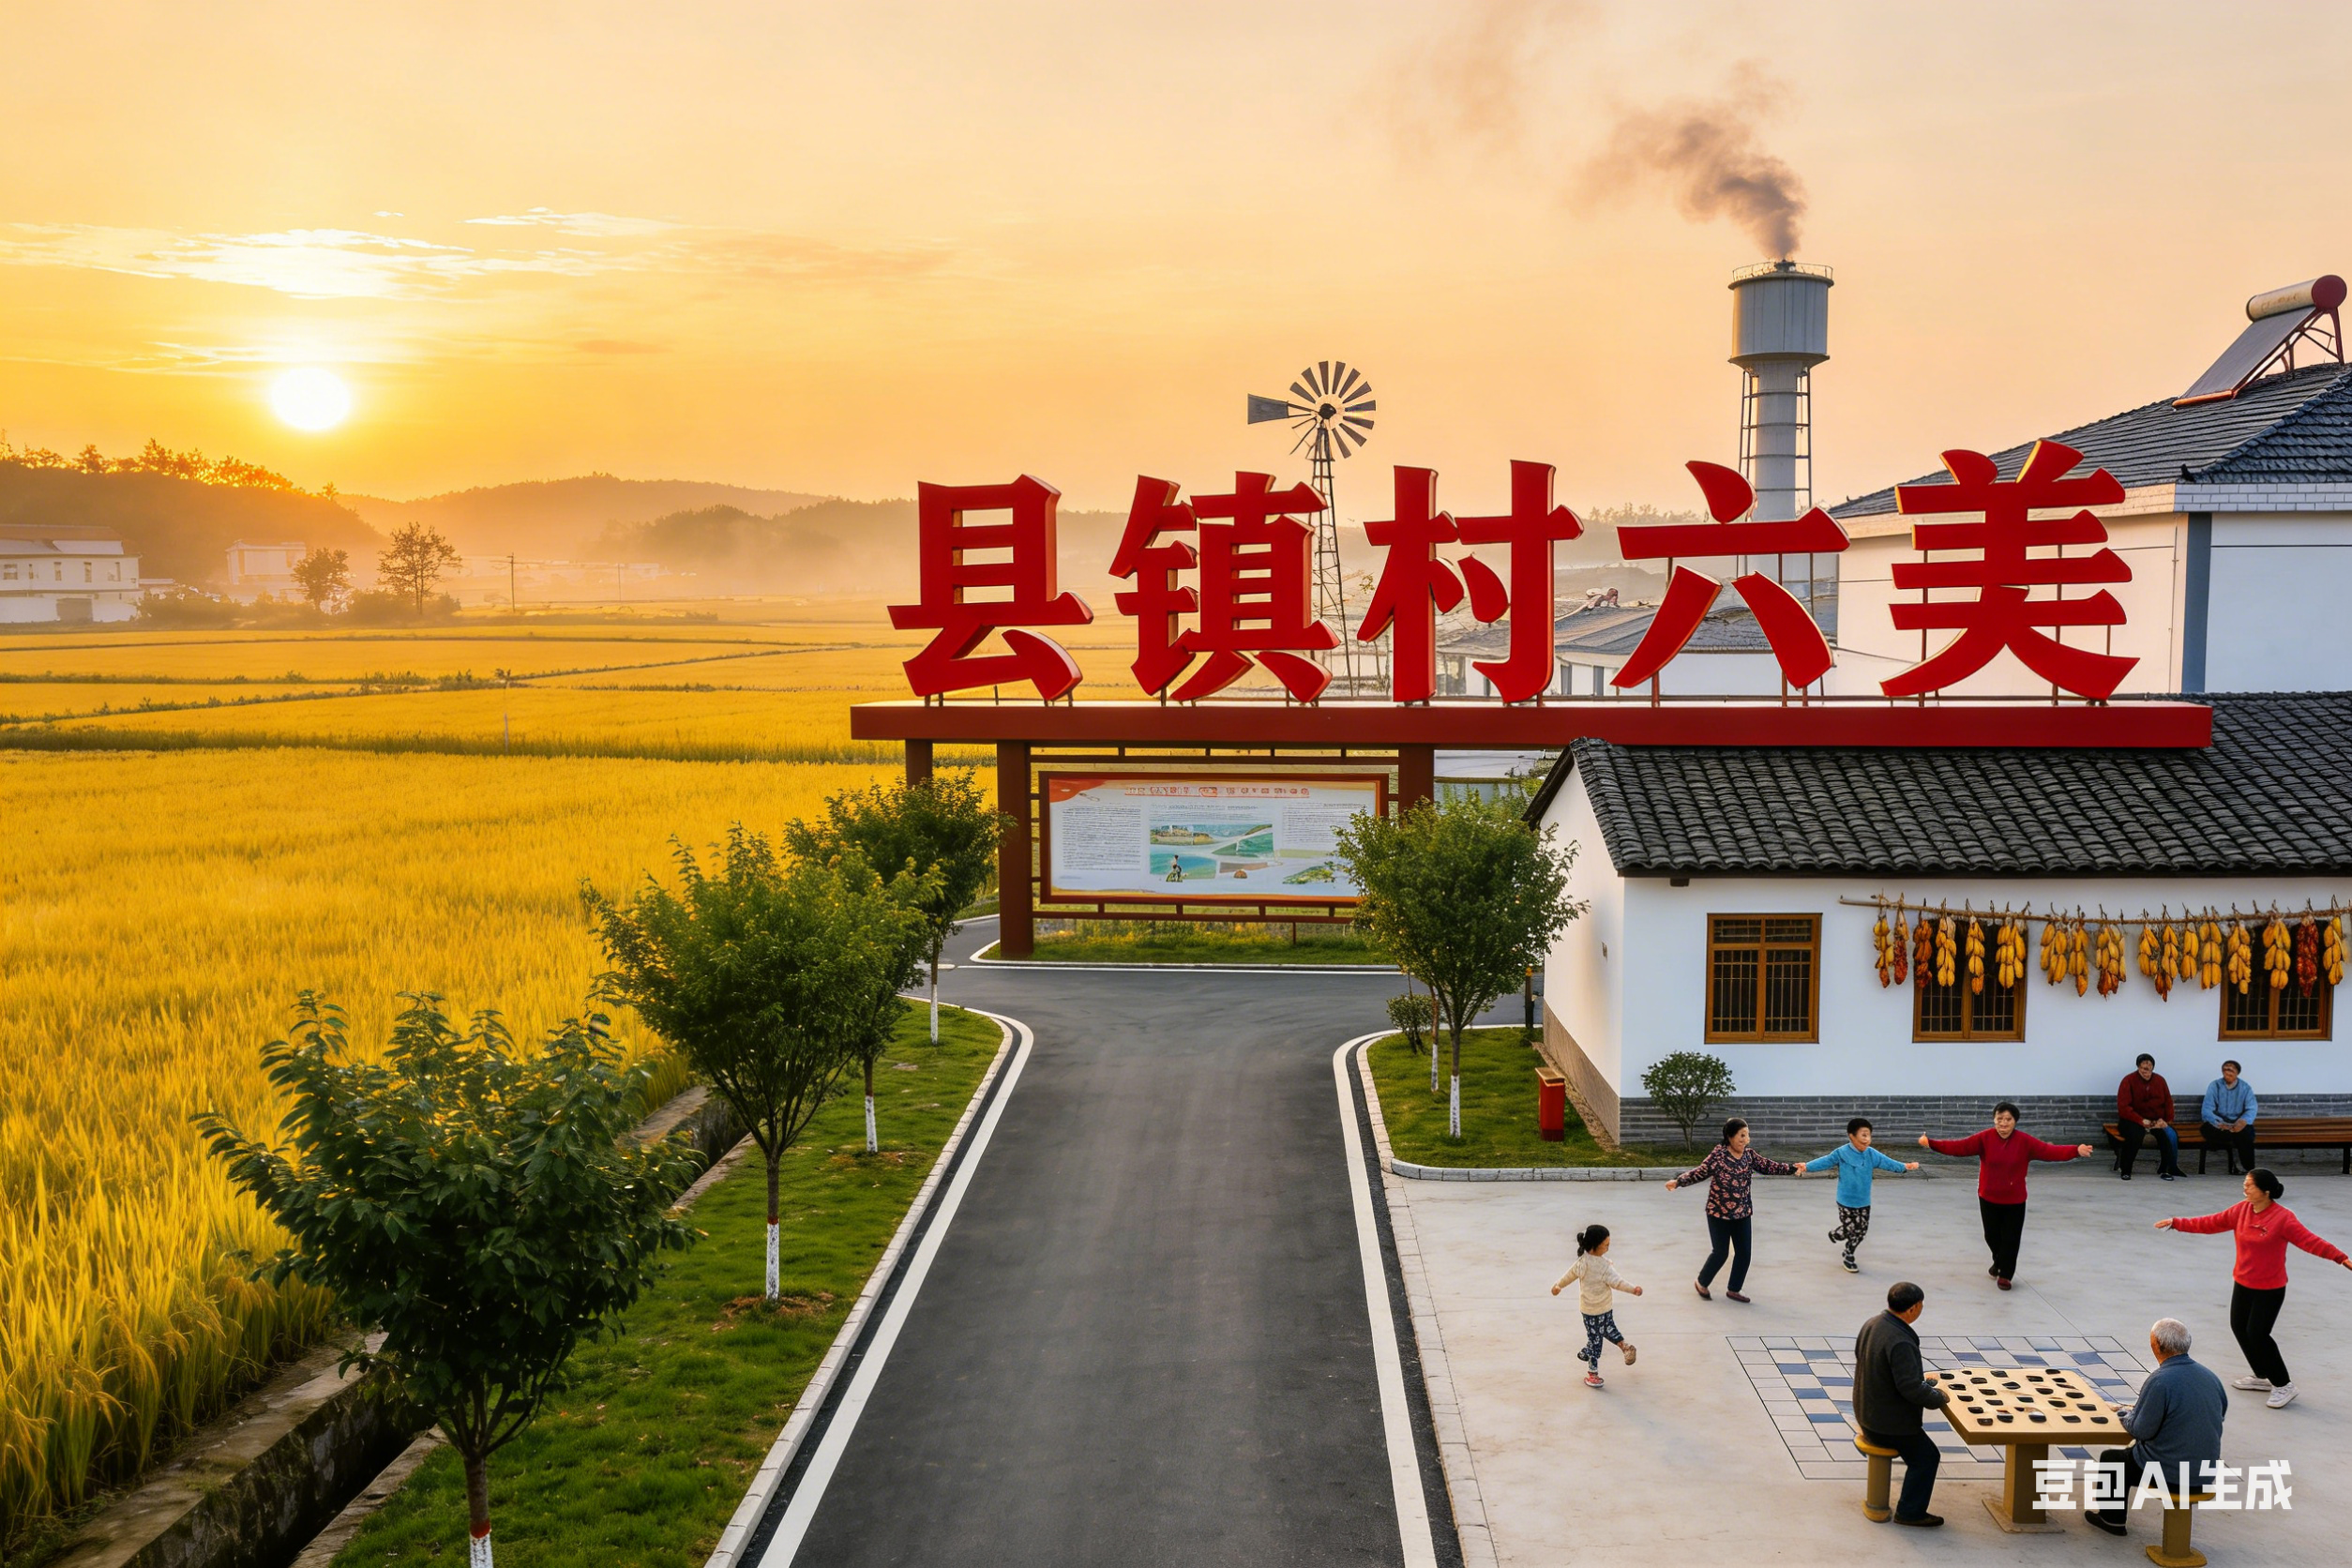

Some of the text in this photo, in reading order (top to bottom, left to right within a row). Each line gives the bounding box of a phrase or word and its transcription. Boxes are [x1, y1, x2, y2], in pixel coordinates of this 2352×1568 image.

[886, 439, 2140, 702] 县镇村六美
